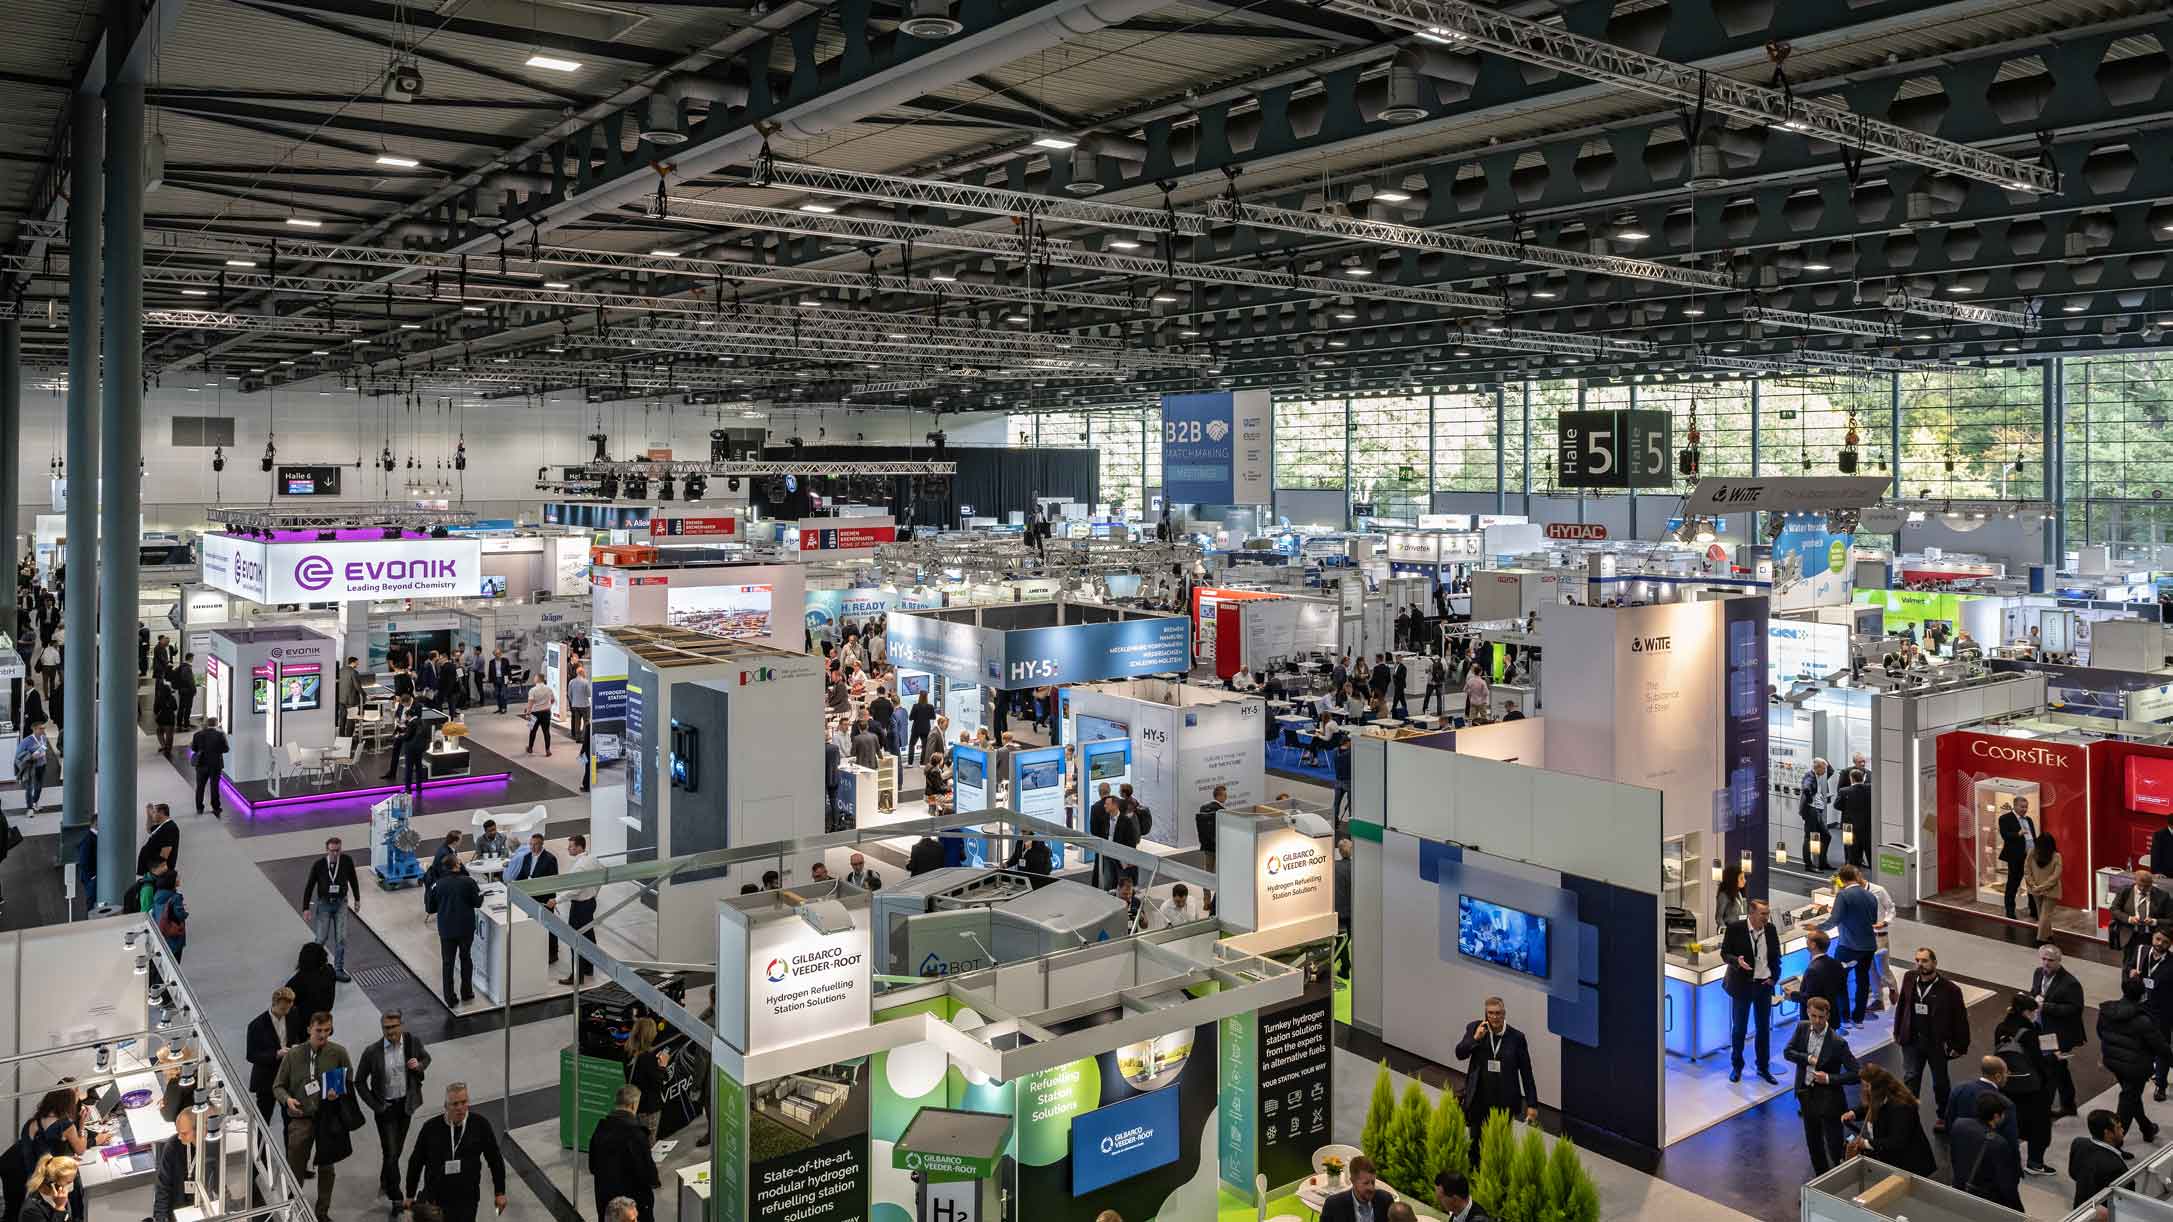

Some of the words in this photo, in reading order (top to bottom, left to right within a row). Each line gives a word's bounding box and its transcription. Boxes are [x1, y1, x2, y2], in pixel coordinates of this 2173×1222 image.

[1166, 421, 1201, 442] B2B
[1166, 448, 1230, 458] MATCHMAKING
[1564, 428, 1577, 474] Halle
[1588, 432, 1612, 474] 5
[1632, 426, 1640, 474] Halle
[1648, 432, 1663, 474] 5
[285, 472, 304, 480] Halle
[306, 472, 311, 480] 6
[1550, 526, 1604, 539] HYDAC
[1404, 544, 1430, 552] drivetek
[242, 560, 264, 582] EVONIK
[345, 559, 457, 582] EVONIK
[346, 584, 380, 593] Leading
[382, 582, 414, 592] Beyond
[415, 580, 456, 592] Chemistry
[853, 601, 886, 611] READY
[1902, 596, 1926, 604] Valmet
[541, 614, 563, 622] Dräger
[285, 647, 320, 656] EVONIK
[1011, 660, 1052, 680] HY-5
[1241, 706, 1258, 716] HY-5
[1144, 728, 1165, 744] HY-5
[1283, 849, 1314, 862] GILBARCO
[1267, 881, 1294, 893] Hydrogen
[1272, 891, 1292, 901] Station
[1292, 886, 1317, 896] Solutions
[792, 947, 842, 965] GILBARCO
[792, 954, 862, 977] VEEDER-ROOT
[766, 989, 809, 1006] Hydrogen
[810, 978, 854, 994] Refuelling
[774, 1002, 805, 1015] Station
[806, 992, 846, 1008] Solutions
[1264, 1019, 1292, 1034] Turnkey
[1292, 1010, 1325, 1026] hydrogen
[1266, 1032, 1290, 1046] station
[1292, 1022, 1322, 1037] solutions
[1266, 1046, 1284, 1058] from
[1284, 1040, 1296, 1051] the
[1297, 1034, 1322, 1048] experts
[1262, 1061, 1270, 1072] in
[1270, 1050, 1308, 1069] alternative
[1308, 1044, 1326, 1057] fuels
[1030, 1072, 1080, 1094] Refuelling
[1262, 1079, 1278, 1089] YOUR
[1300, 1066, 1315, 1076] YOUR
[1316, 1062, 1328, 1072] WAY
[1038, 1087, 1072, 1106] Station
[1032, 1101, 1077, 1122] Solutions
[1114, 1126, 1143, 1142] GILBARCO
[1114, 1130, 1154, 1149] VEEDER-ROOT
[763, 1150, 854, 1184] State-of-the-art,
[924, 1154, 962, 1164] GILBARCO
[924, 1162, 976, 1174] VEEDER-ROOT
[758, 1180, 806, 1202] modular
[807, 1164, 859, 1189] hydrogen
[761, 1191, 816, 1217] refuelling
[818, 1180, 855, 1200] station
[784, 1202, 834, 1222] solutions
